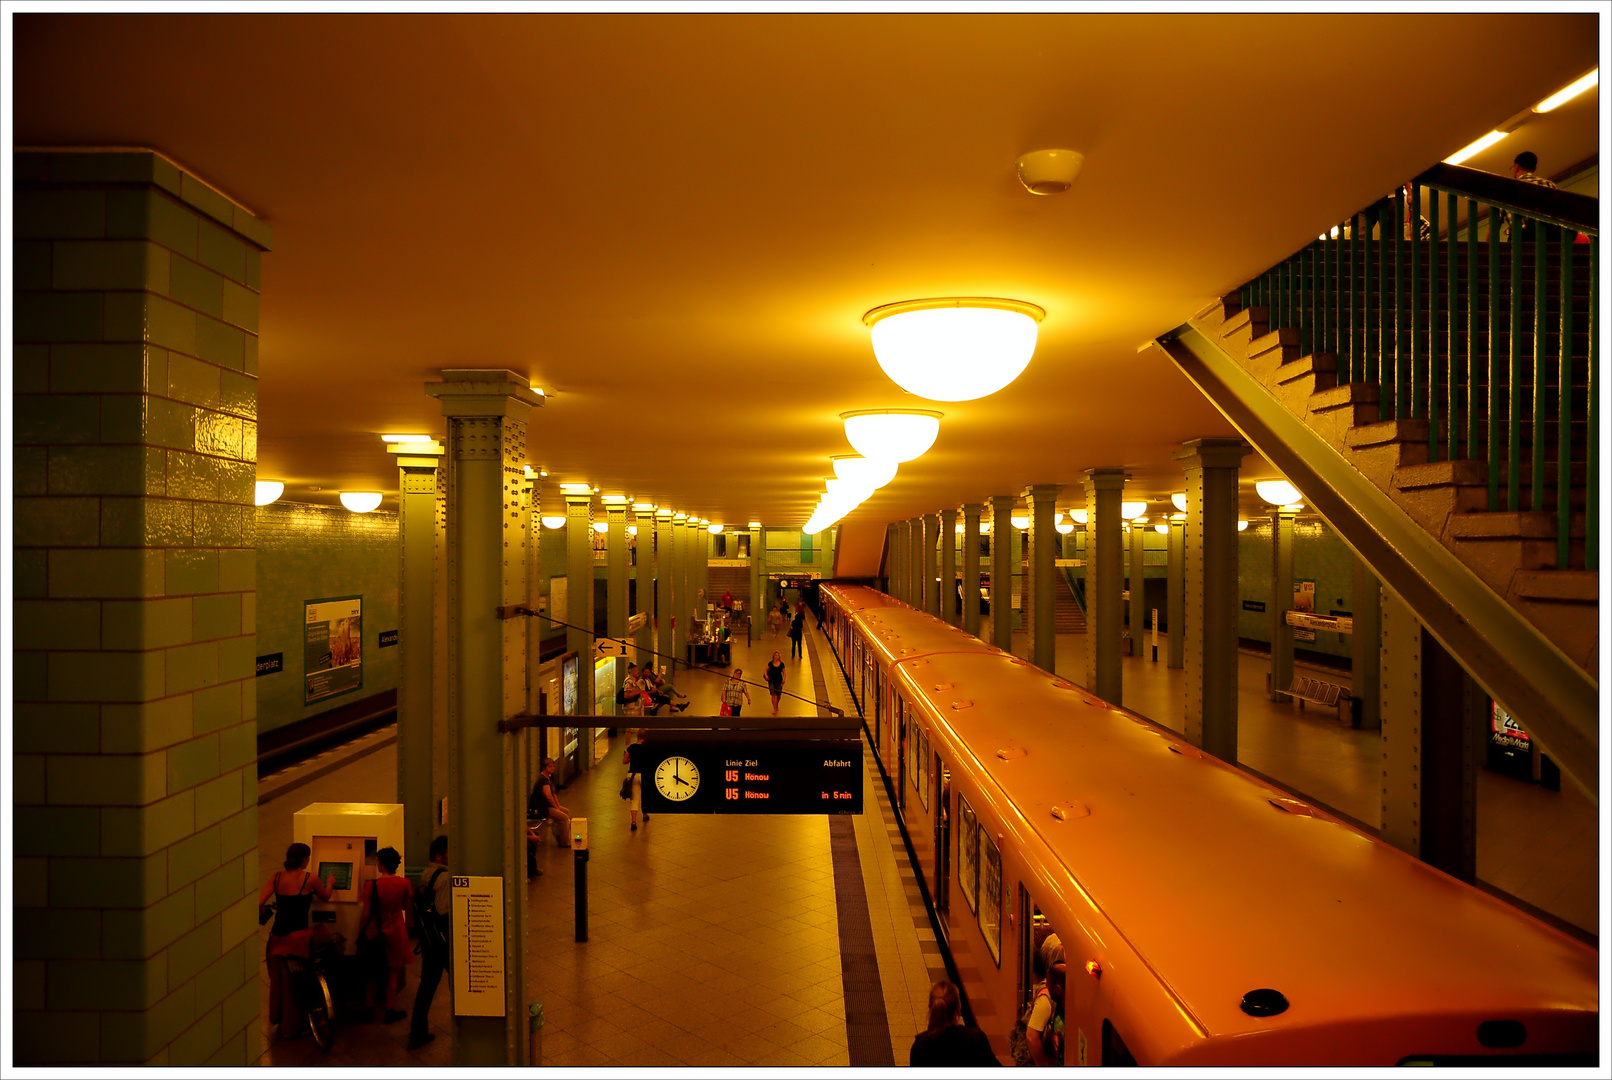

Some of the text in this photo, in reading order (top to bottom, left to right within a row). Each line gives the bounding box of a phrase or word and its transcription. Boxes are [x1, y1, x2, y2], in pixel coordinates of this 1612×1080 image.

[726, 770, 738, 782] U5
[726, 788, 738, 800] U5
[822, 791, 829, 799] in
[454, 878, 468, 887] U5
